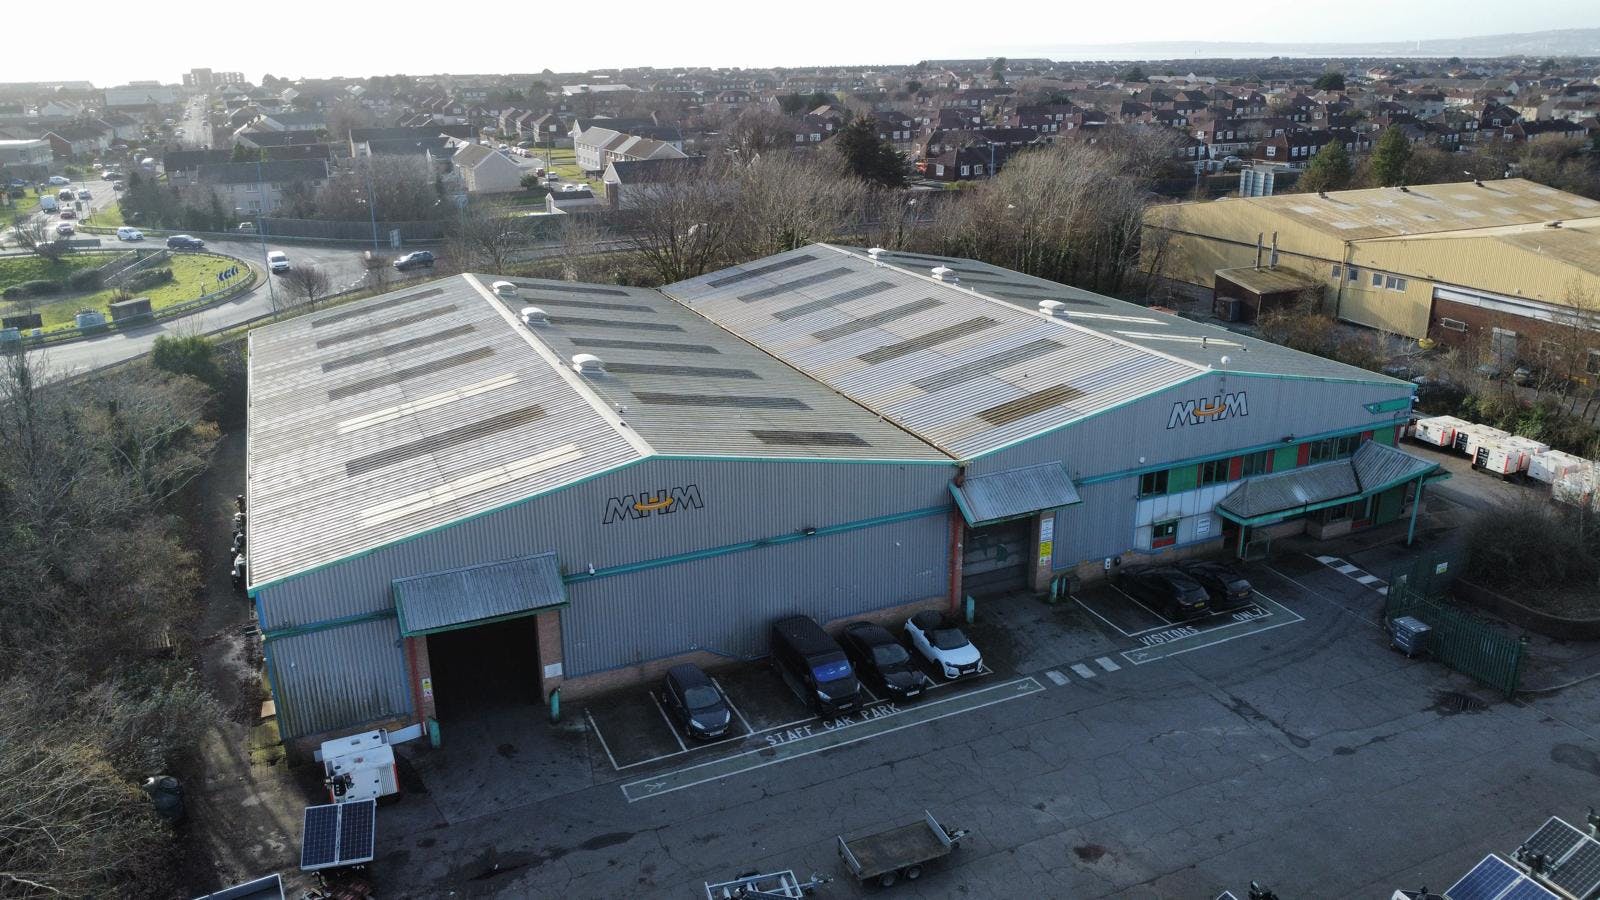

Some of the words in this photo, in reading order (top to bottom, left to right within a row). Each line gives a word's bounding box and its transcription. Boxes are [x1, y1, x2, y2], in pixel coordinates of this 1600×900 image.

[1166, 391, 1249, 430] MHM
[602, 484, 704, 524] MHM
[1139, 625, 1199, 646] VISITORS
[1232, 607, 1264, 621] ONLY
[765, 725, 813, 745] STAFF
[823, 715, 855, 730] CAR
[860, 702, 901, 720] PARK
